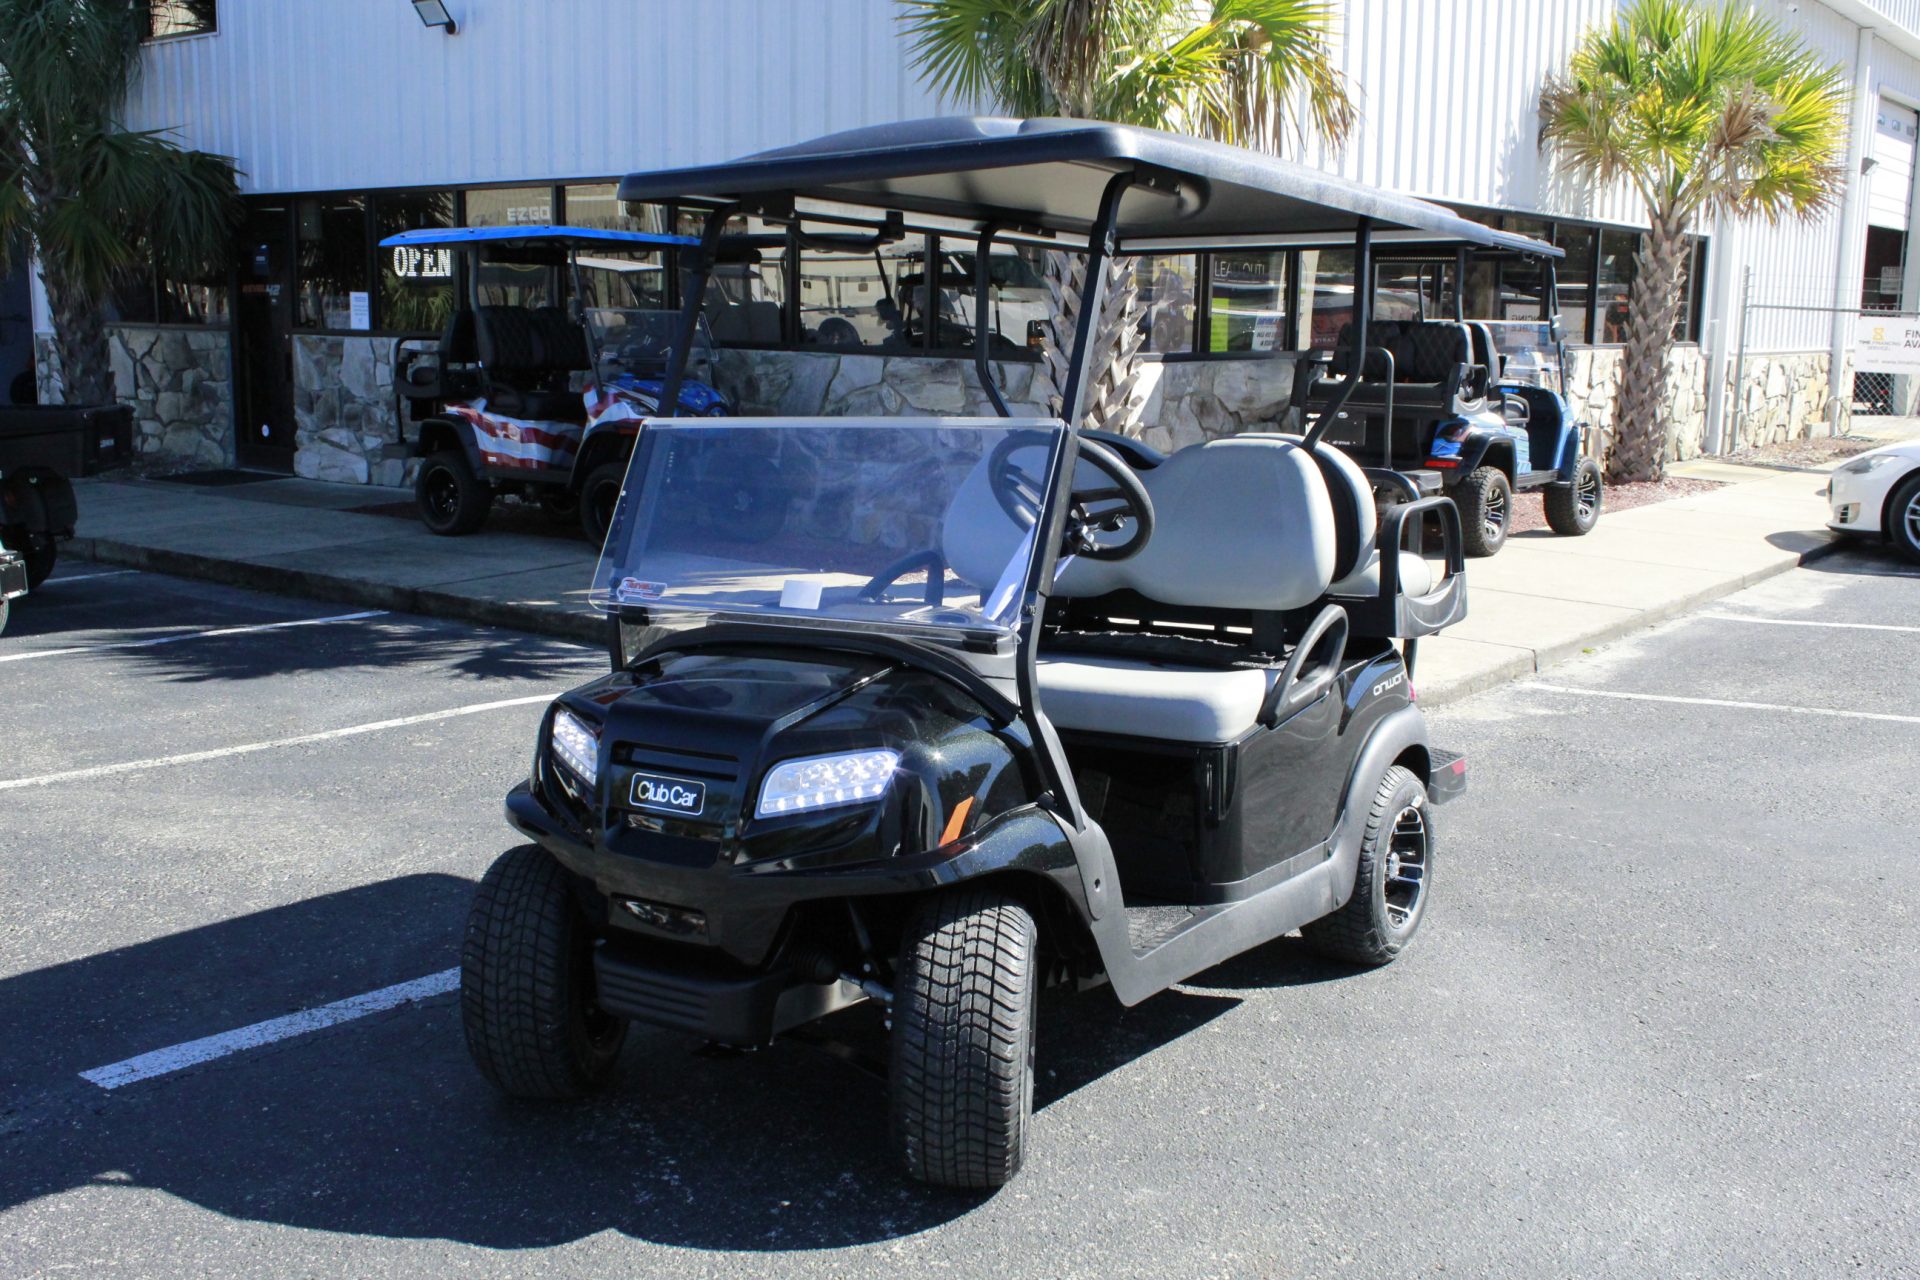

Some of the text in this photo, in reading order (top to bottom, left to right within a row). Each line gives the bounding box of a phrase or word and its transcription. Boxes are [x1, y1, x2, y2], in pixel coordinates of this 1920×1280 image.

[507, 206, 551, 221] EZGO
[393, 246, 451, 277] OPEN
[1904, 339, 1920, 348] AV
[638, 781, 697, 807] Club Car
